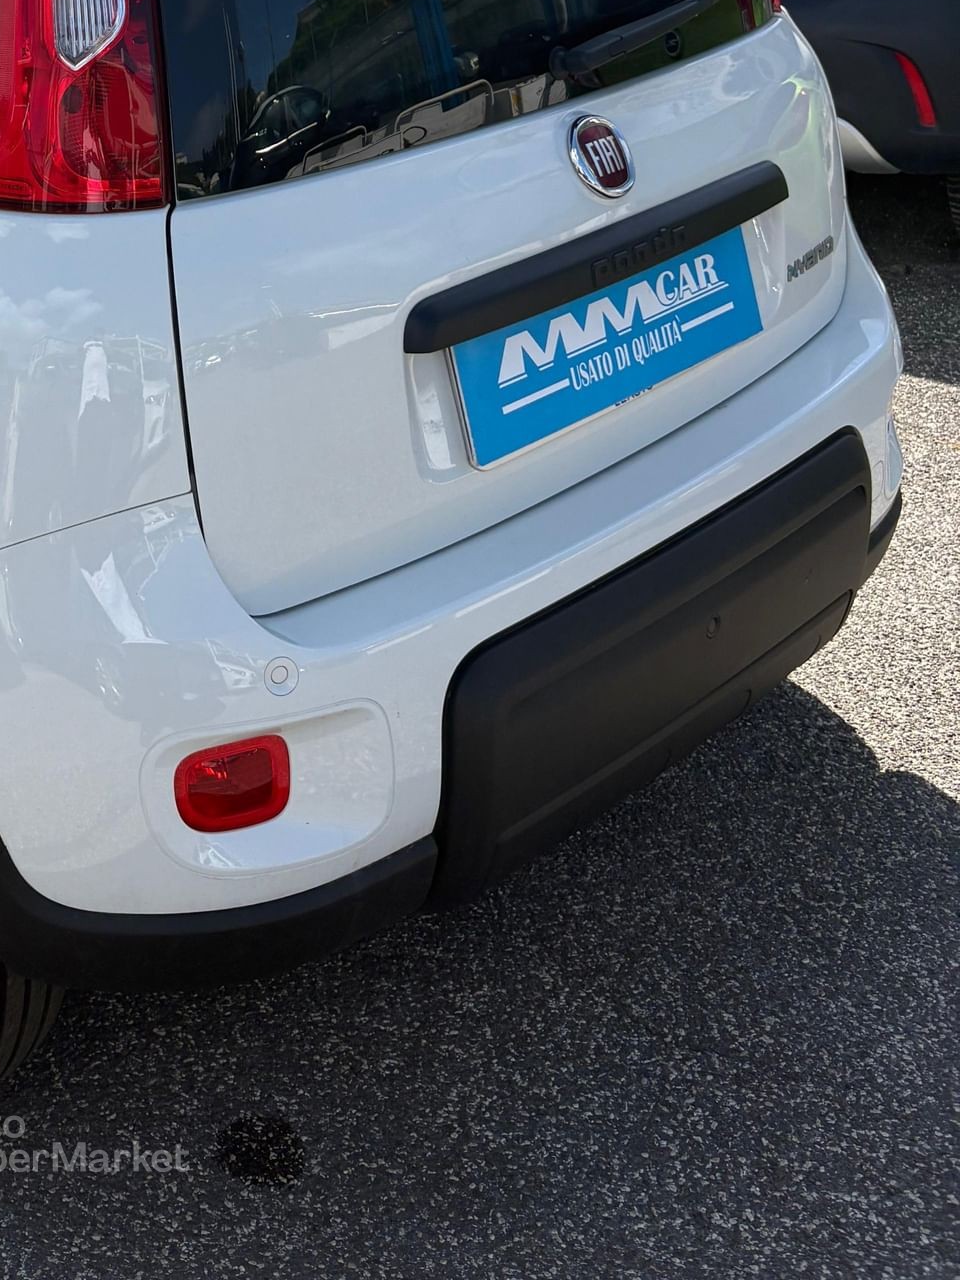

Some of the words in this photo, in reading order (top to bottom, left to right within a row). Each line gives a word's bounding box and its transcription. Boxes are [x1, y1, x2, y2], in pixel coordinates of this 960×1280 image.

[585, 135, 624, 177] FIAT
[570, 352, 613, 391] USATO
[615, 343, 631, 371] DI
[632, 315, 682, 365] QUALITÀ
